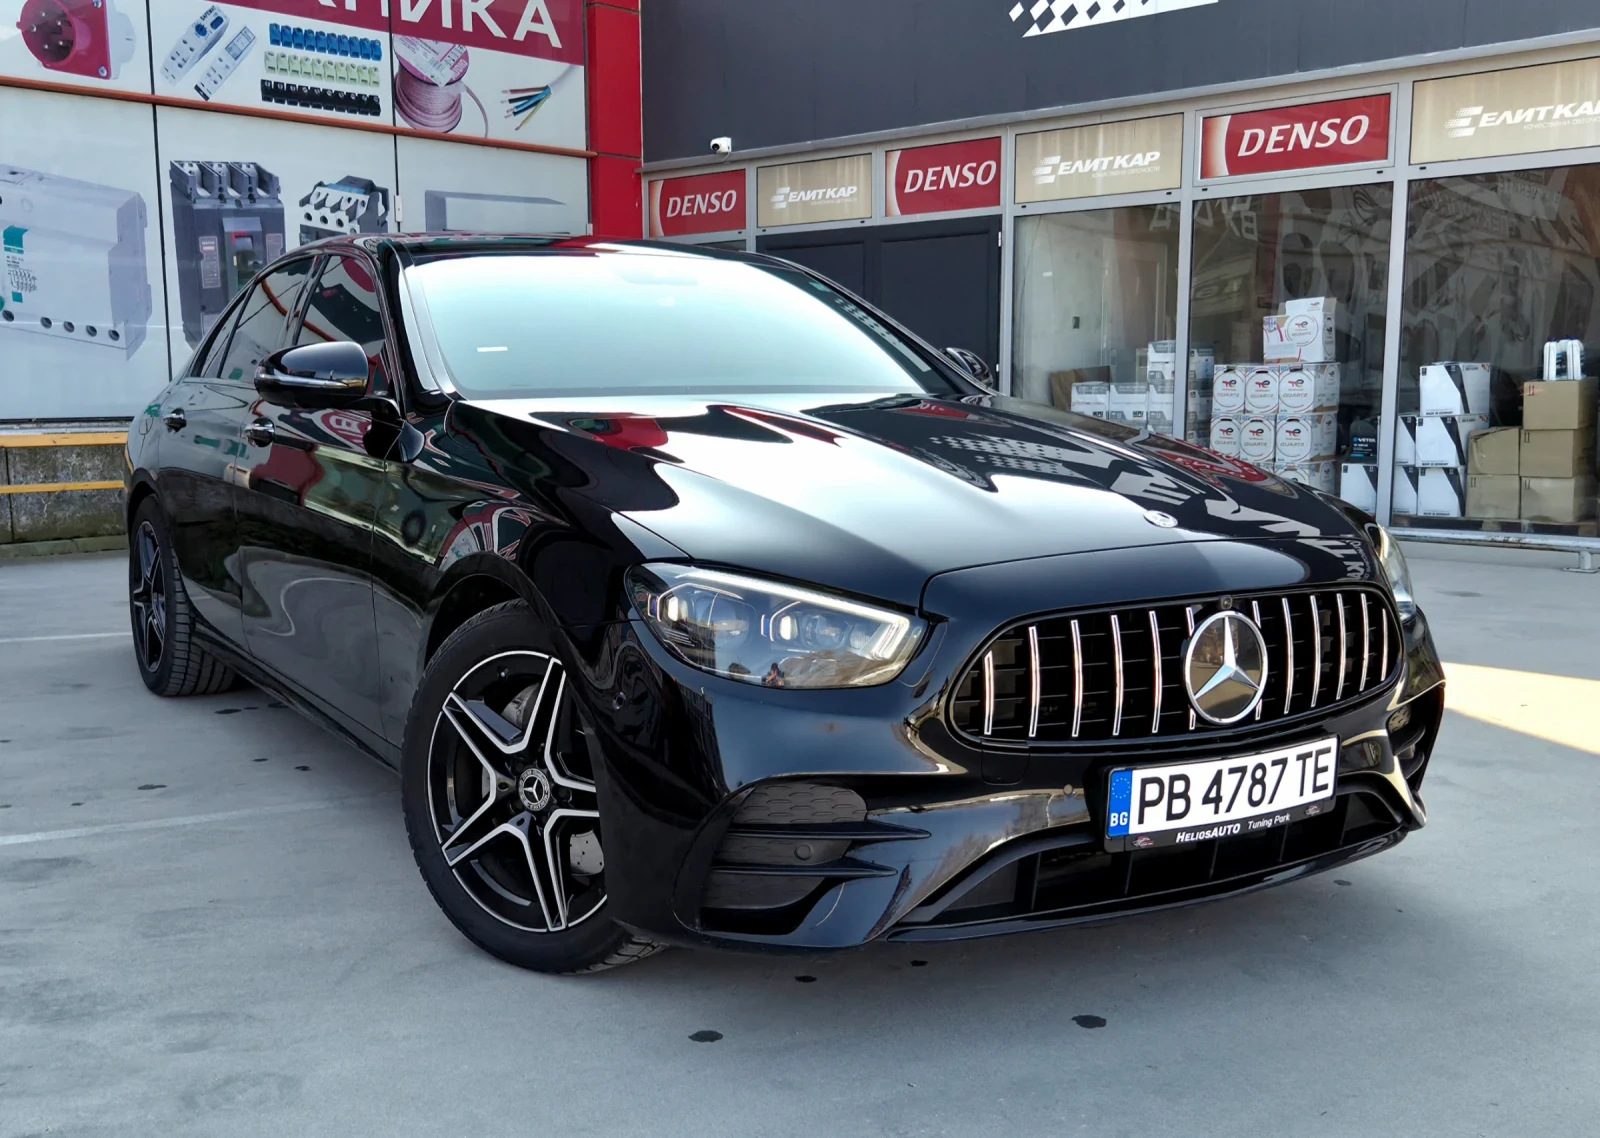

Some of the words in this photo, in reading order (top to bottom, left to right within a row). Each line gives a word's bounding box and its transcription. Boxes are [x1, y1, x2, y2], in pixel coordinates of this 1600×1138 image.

[1237, 115, 1370, 157] DENSO
[904, 160, 997, 194] DENSO
[666, 189, 738, 219] DENSO
[1137, 773, 1191, 825] PB
[1201, 756, 1288, 815] 4787
[1296, 746, 1332, 797] TE
[1110, 812, 1128, 826] BG
[1248, 818, 1272, 830] Tuning
[1274, 812, 1290, 824] Park
